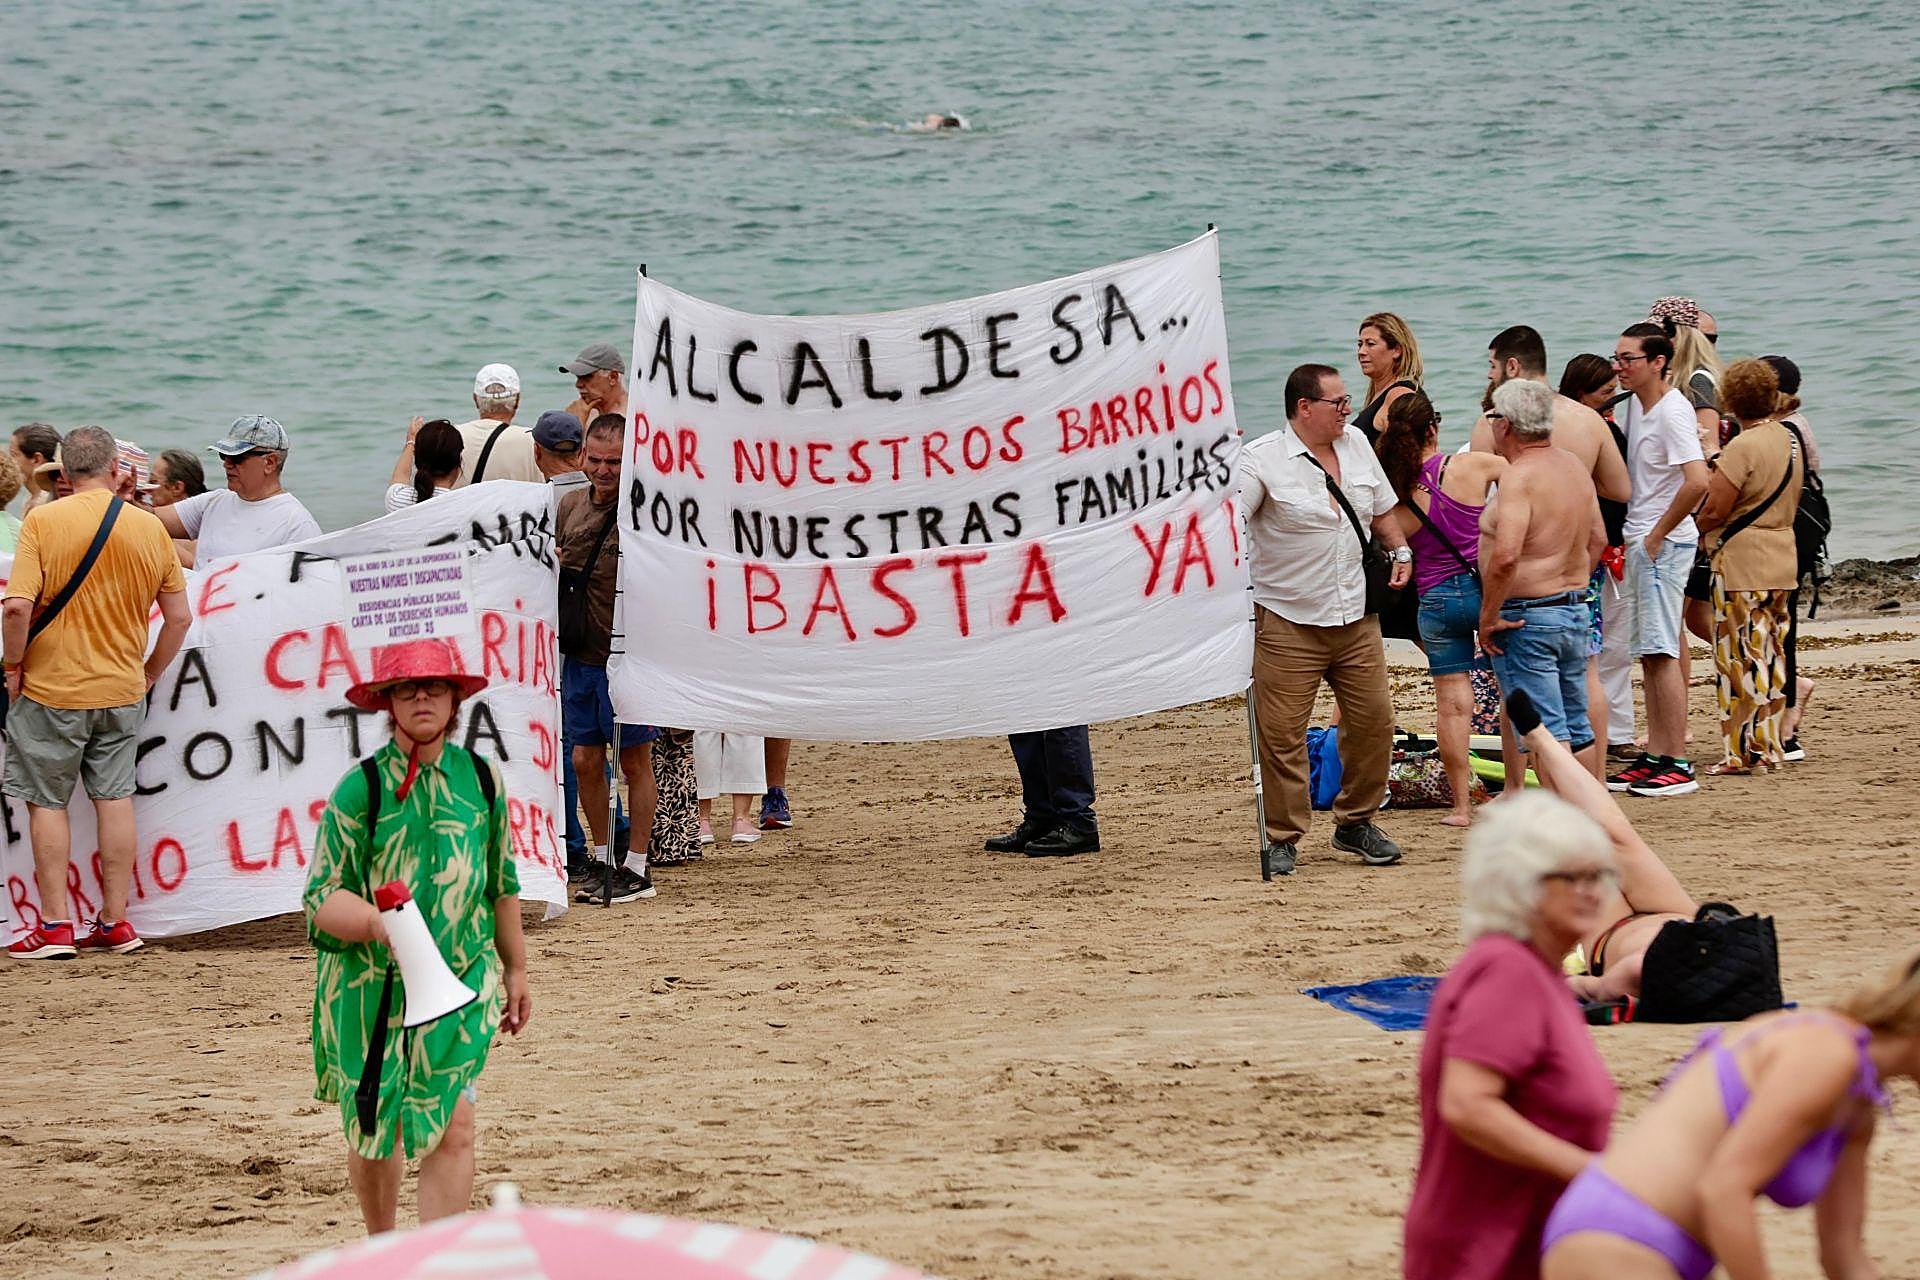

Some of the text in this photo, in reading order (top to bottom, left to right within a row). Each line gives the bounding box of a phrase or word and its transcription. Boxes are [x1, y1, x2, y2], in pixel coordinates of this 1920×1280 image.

[633, 409, 705, 480] POR
[733, 416, 1024, 489] NUESTROS
[630, 478, 707, 547] POR
[733, 491, 1021, 559] NUESTRAS
[351, 601, 468, 628] CARTA DE LOS DERECHOS HUMANOS
[358, 599, 401, 613] RESIDENCIAS
[135, 698, 509, 797] CONTA
[224, 799, 327, 871] LA
